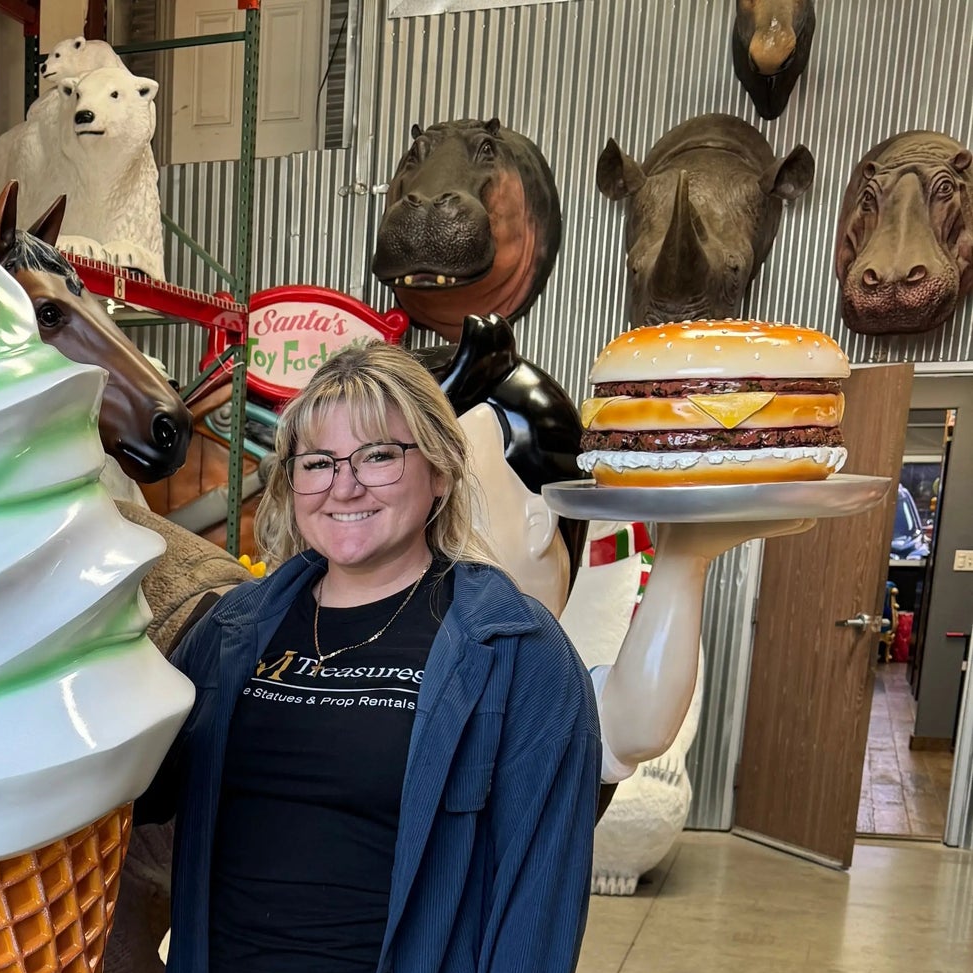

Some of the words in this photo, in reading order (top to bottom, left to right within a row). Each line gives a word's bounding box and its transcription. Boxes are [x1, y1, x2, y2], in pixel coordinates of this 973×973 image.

[117, 278, 123, 298] 8
[254, 309, 348, 336] Santa's
[246, 337, 278, 375] Toy
[283, 335, 369, 375] Fact
[252, 688, 303, 704] Statues
[305, 696, 316, 704] &
[319, 696, 355, 708] Prop
[358, 696, 416, 710] Rentals
